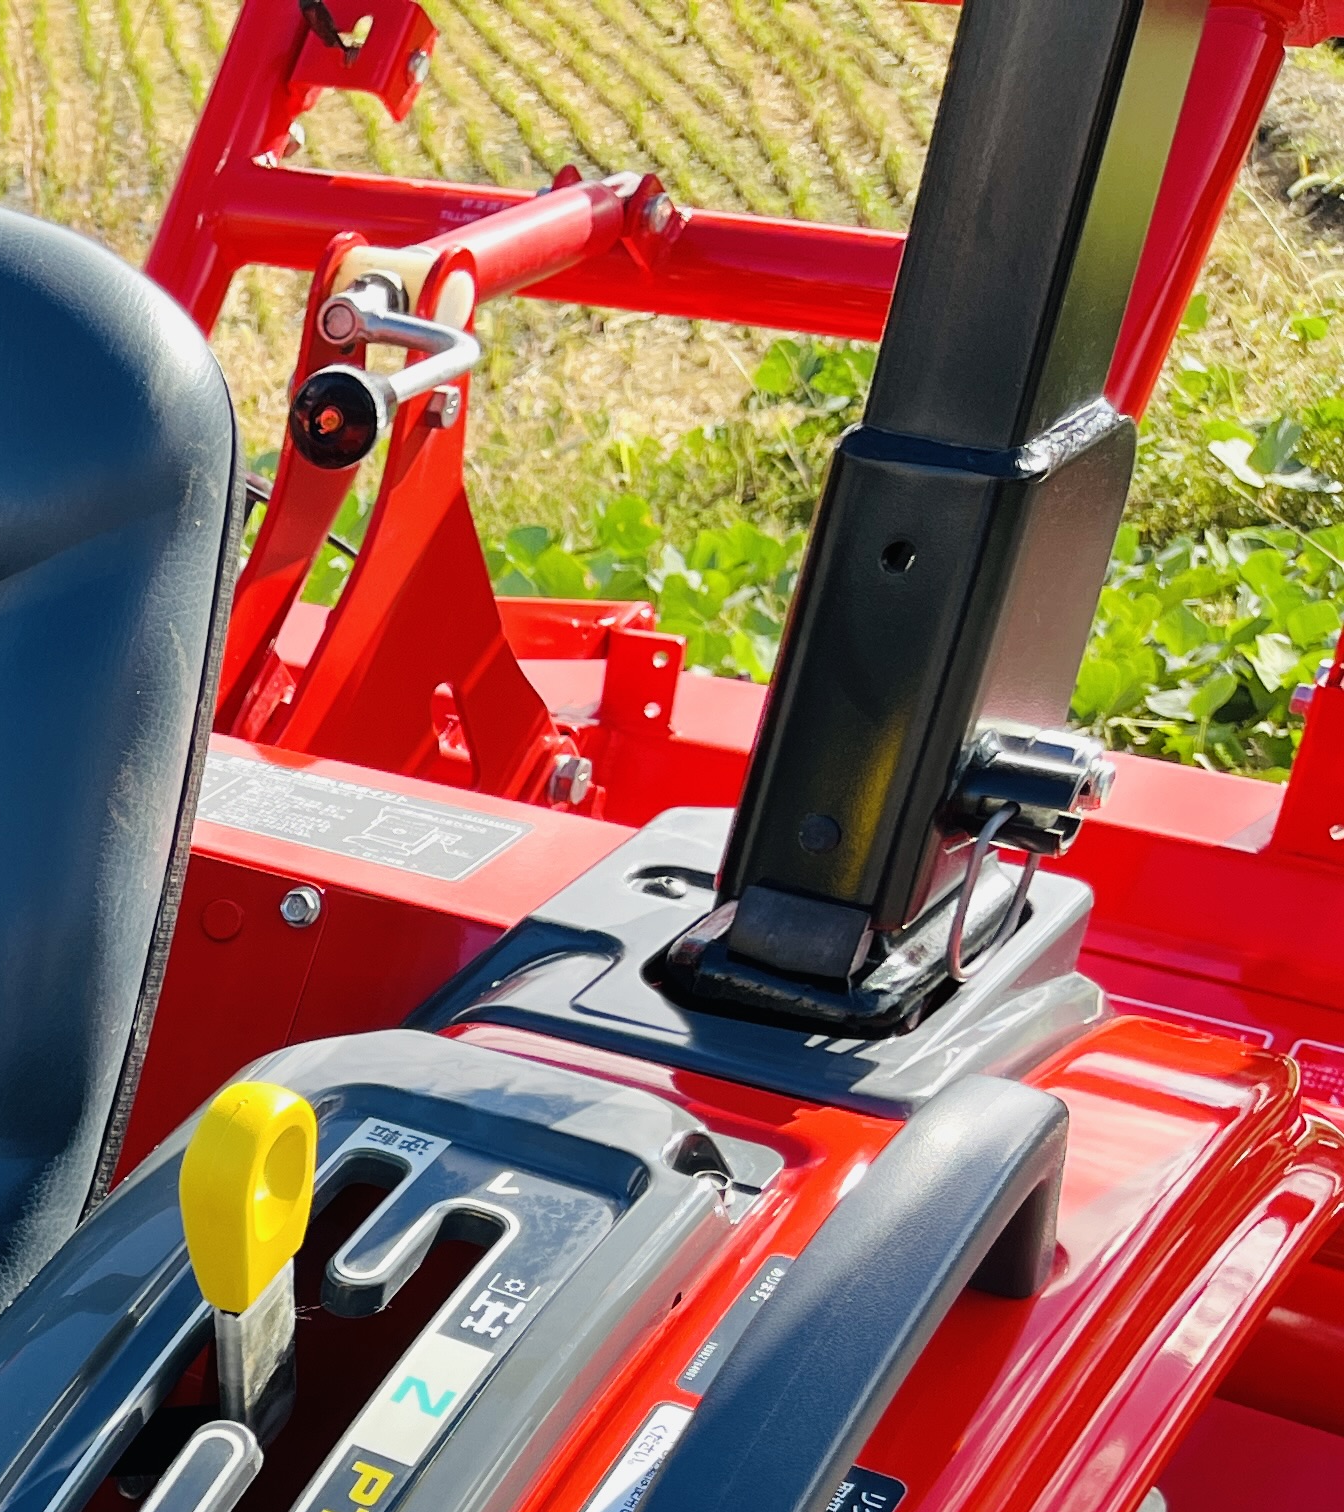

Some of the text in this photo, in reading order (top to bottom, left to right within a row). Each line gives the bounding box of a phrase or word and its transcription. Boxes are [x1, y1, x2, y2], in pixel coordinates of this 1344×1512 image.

[366, 1125, 434, 1155] 逆転
[486, 1172, 520, 1194] 1
[390, 1375, 457, 1418] N
[624, 1423, 669, 1467] ください。
